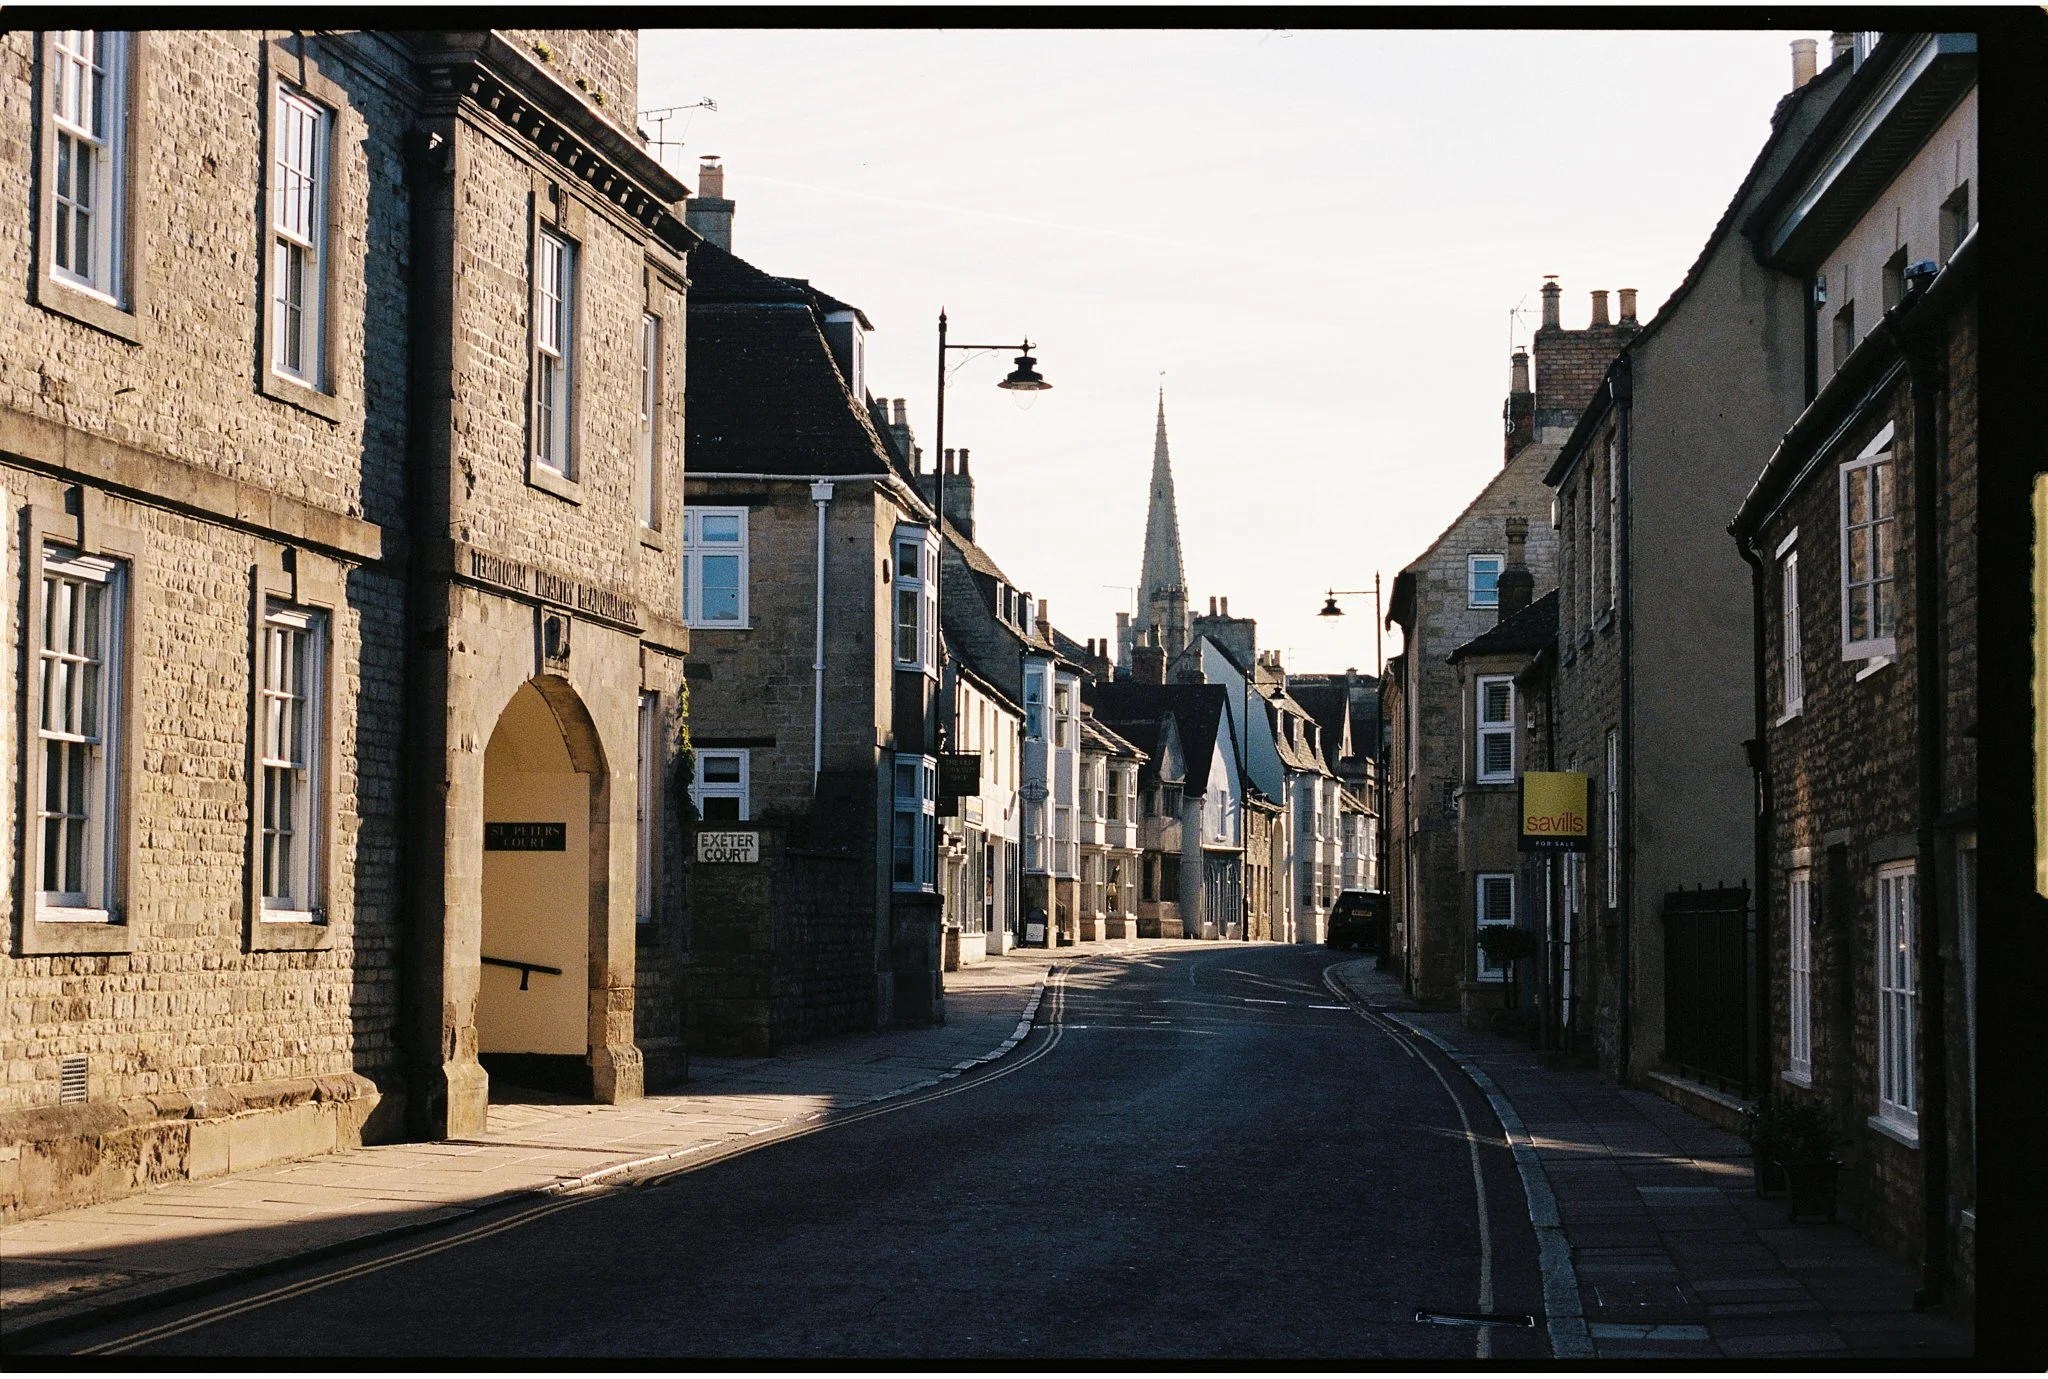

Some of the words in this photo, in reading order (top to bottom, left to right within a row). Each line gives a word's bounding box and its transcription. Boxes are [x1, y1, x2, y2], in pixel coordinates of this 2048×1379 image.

[471, 549, 529, 592] TERRITORIAL
[535, 570, 574, 605] INFANTRY
[1526, 811, 1584, 832] savills
[513, 825, 560, 836] PETERS
[503, 837, 545, 848] COURT
[701, 834, 754, 847] EXETER
[704, 848, 750, 861] COURT
